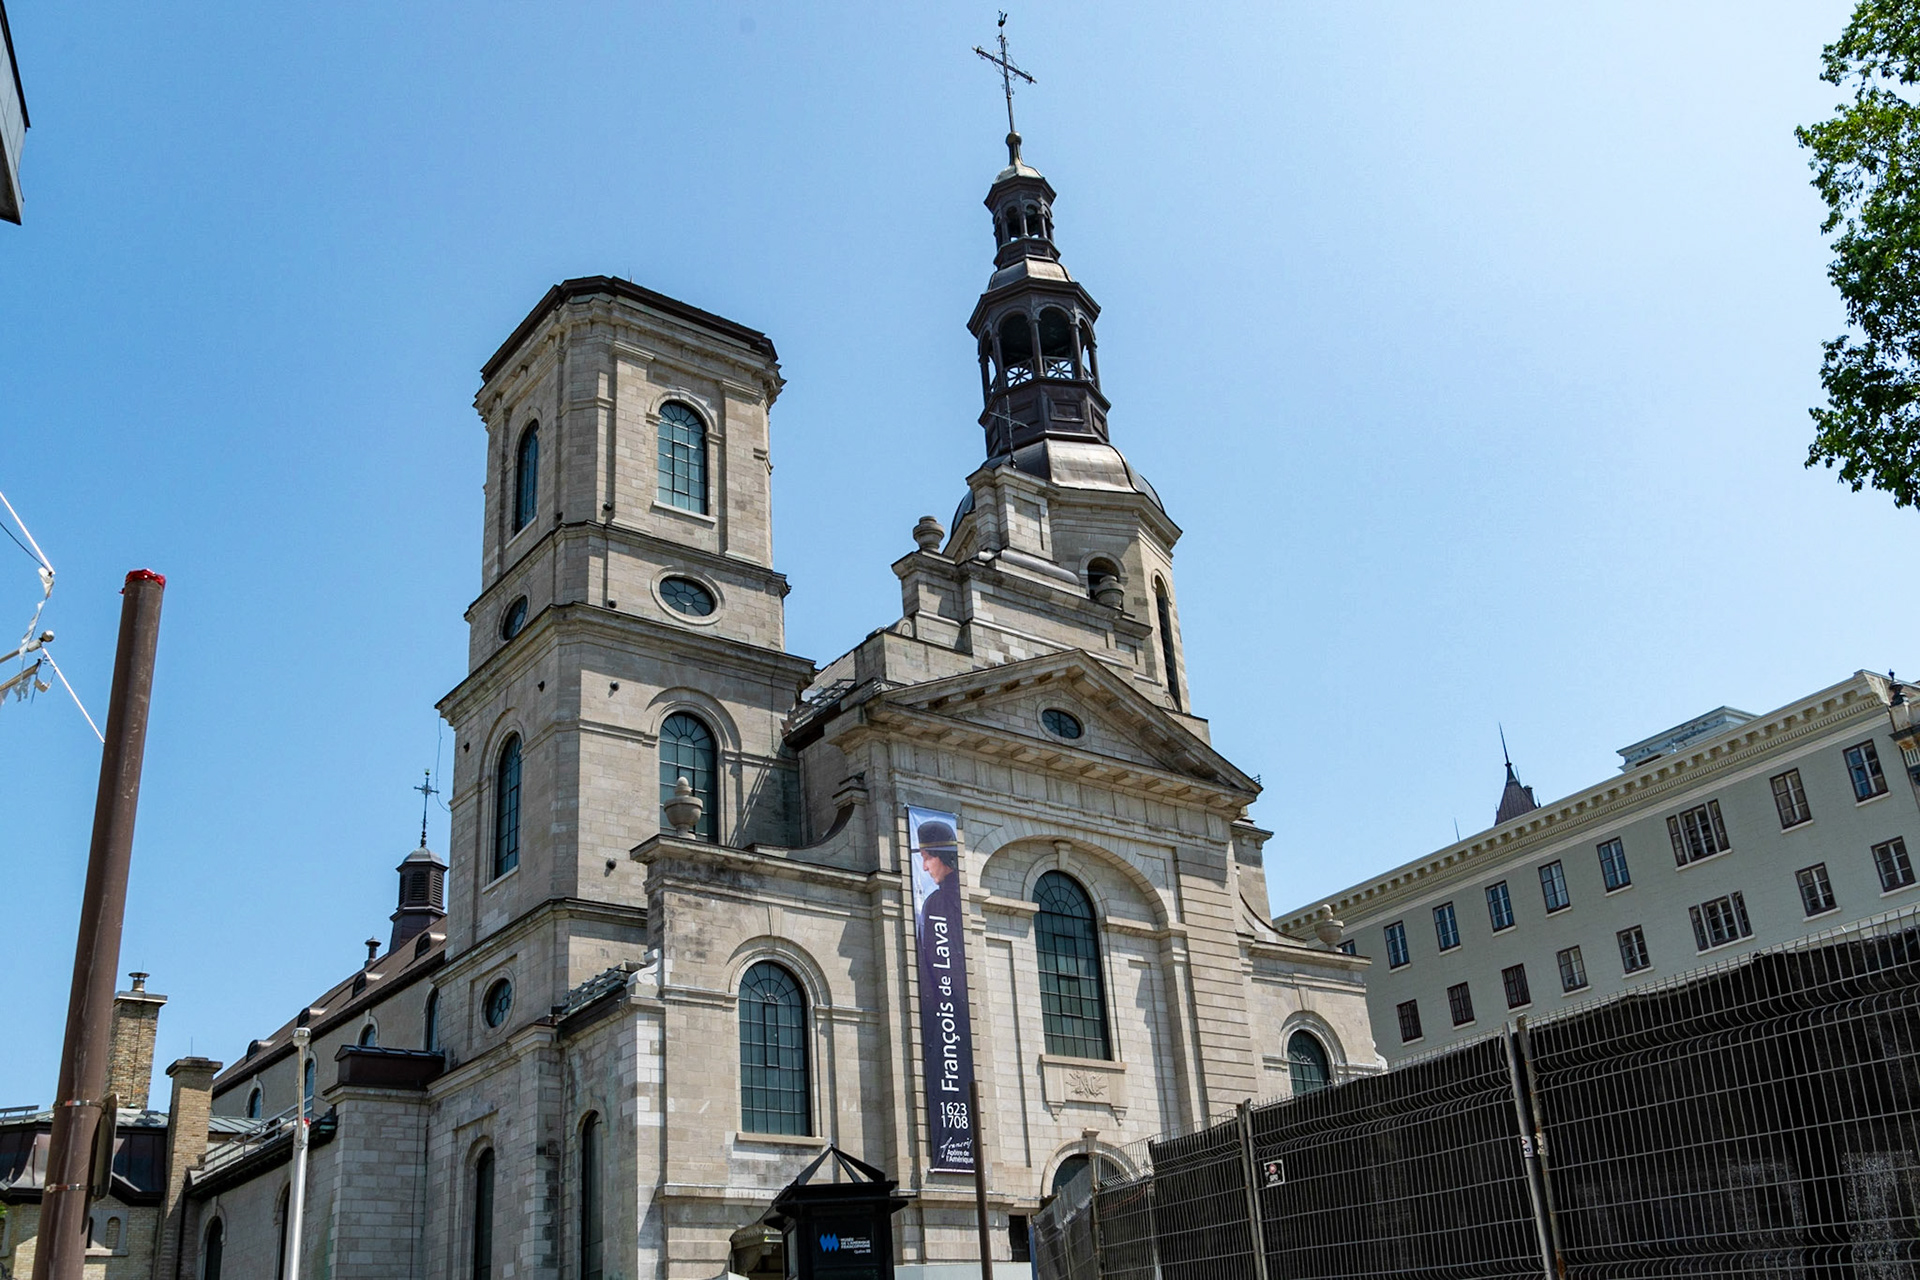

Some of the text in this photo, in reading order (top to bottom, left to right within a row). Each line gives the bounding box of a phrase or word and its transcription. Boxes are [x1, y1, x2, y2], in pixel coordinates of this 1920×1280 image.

[929, 915, 960, 1092] François de Laval
[940, 1102, 967, 1116] 1623
[941, 1115, 969, 1129] 1708
